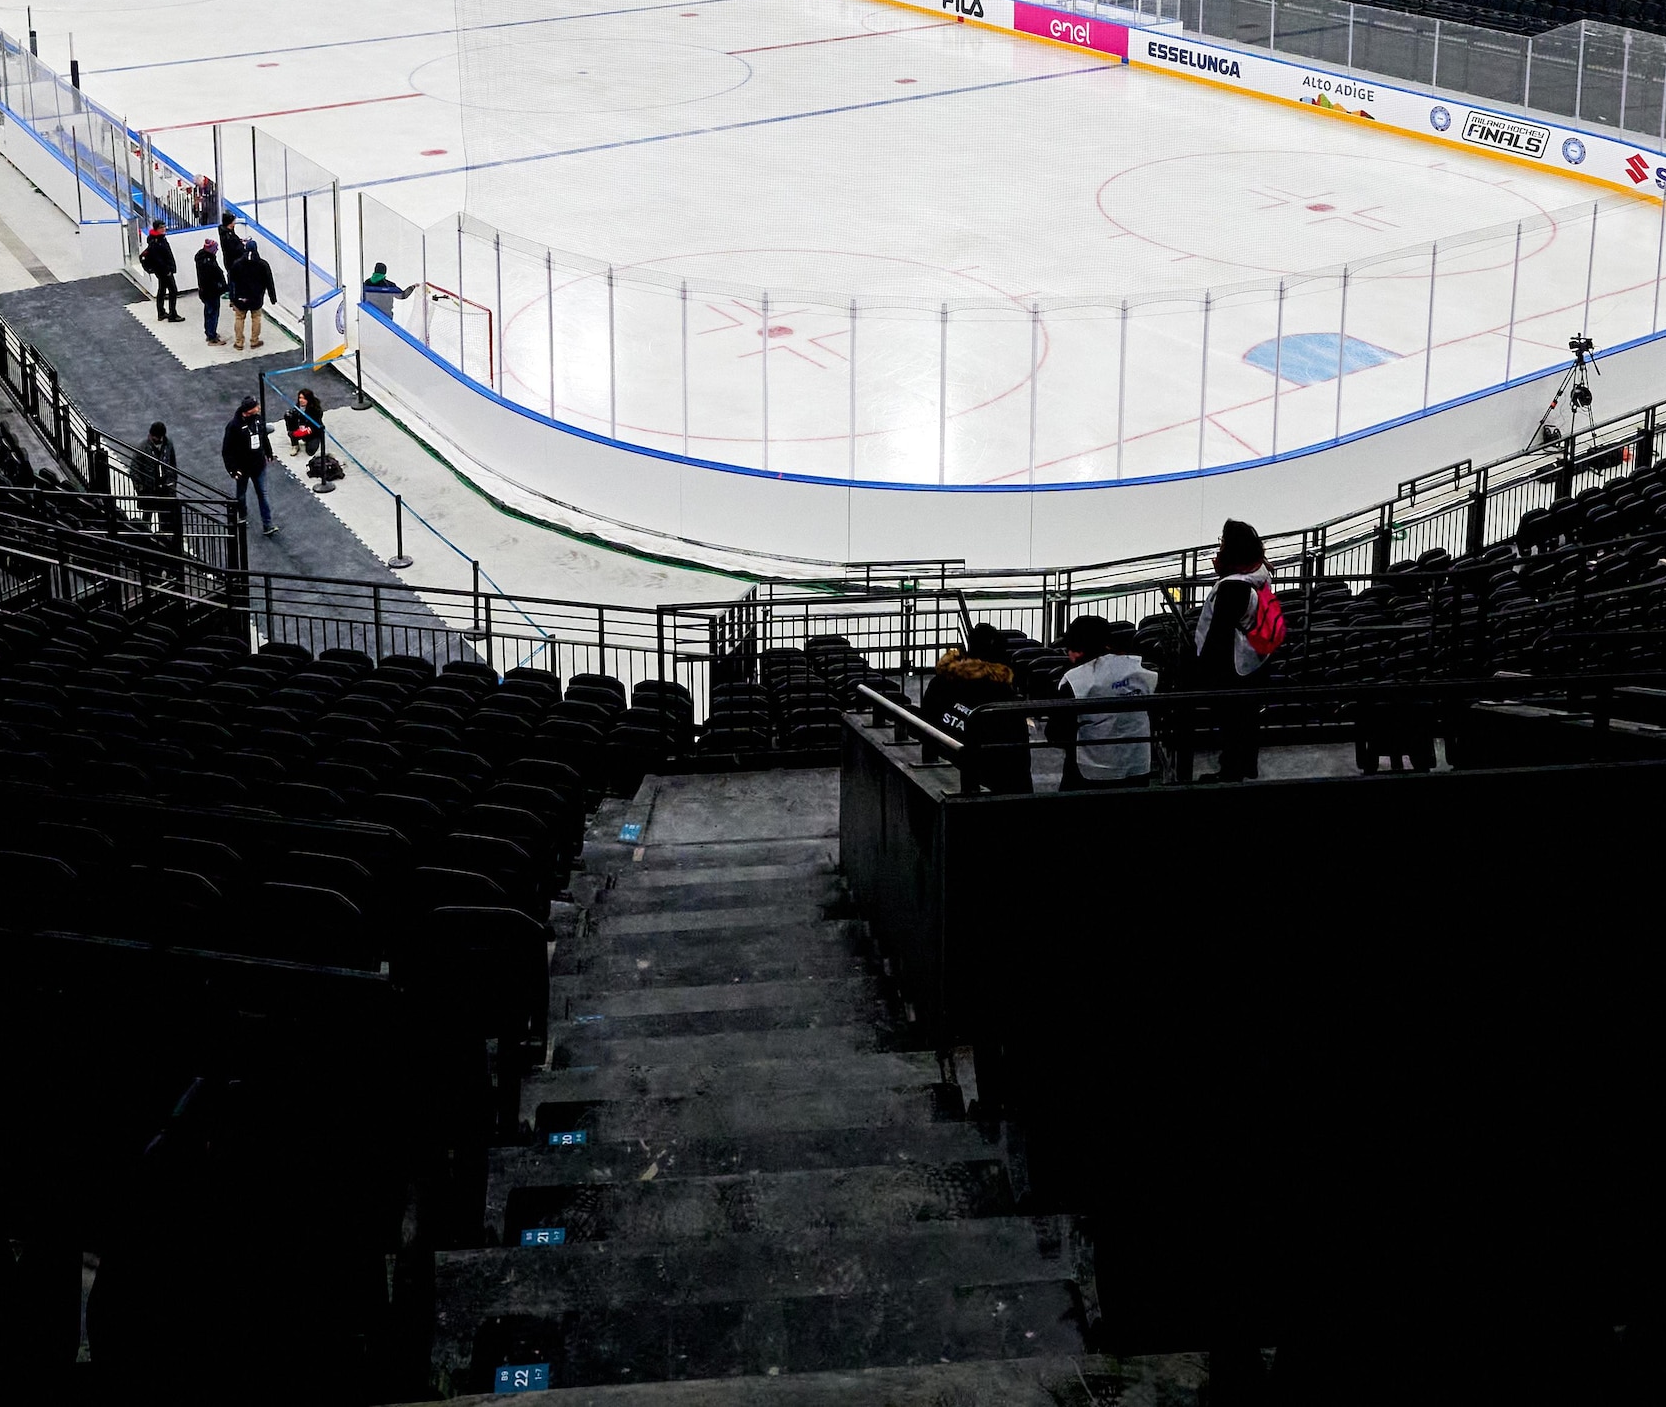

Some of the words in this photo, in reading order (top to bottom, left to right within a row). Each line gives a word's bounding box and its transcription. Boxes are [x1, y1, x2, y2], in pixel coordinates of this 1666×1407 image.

[1050, 19, 1091, 45] enel
[1148, 41, 1241, 79] ESSELUNGA
[1471, 116, 1505, 130] MILANO
[1506, 123, 1545, 139] HOCKEY
[1467, 123, 1542, 153] FINALS
[943, 713, 965, 731] STA
[537, 1231, 550, 1243] 21
[514, 1369, 529, 1387] 22
[534, 1368, 543, 1380] 1-7
